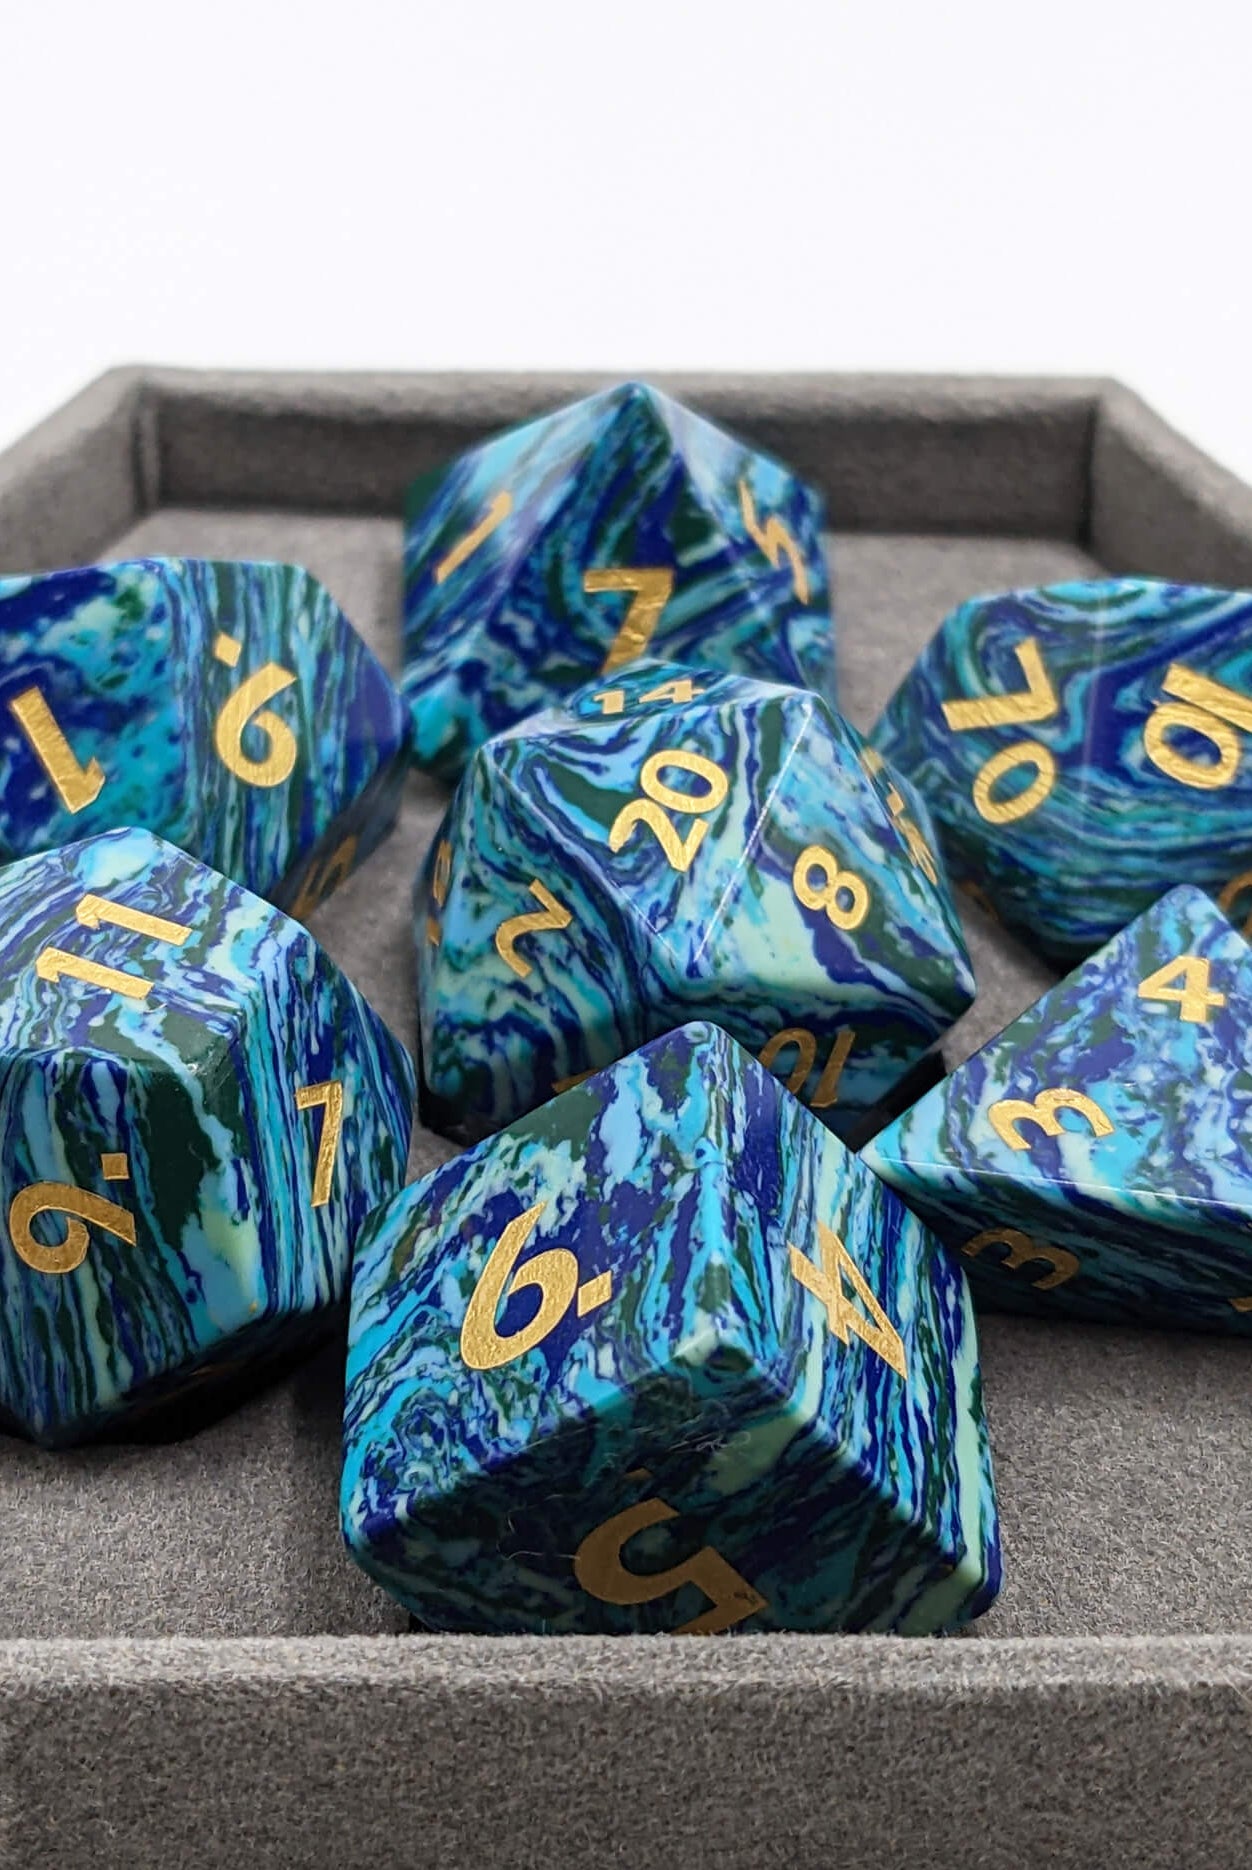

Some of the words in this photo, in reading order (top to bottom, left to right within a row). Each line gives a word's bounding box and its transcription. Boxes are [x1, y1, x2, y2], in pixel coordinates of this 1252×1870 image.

[435, 490, 513, 585] 1
[584, 567, 674, 674] 7
[594, 678, 707, 715] 14
[941, 636, 1059, 825] 70
[11, 686, 106, 815] 1
[608, 749, 729, 873] 20
[495, 879, 573, 978] 2
[792, 845, 869, 931] 8
[36, 893, 192, 1001] 11
[1138, 955, 1225, 1024] 4
[296, 1080, 343, 1208] 7
[988, 1087, 1115, 1152] 3
[787, 1222, 908, 1381] 4
[961, 1227, 1080, 1290] 3
[574, 1497, 769, 1634] 5
